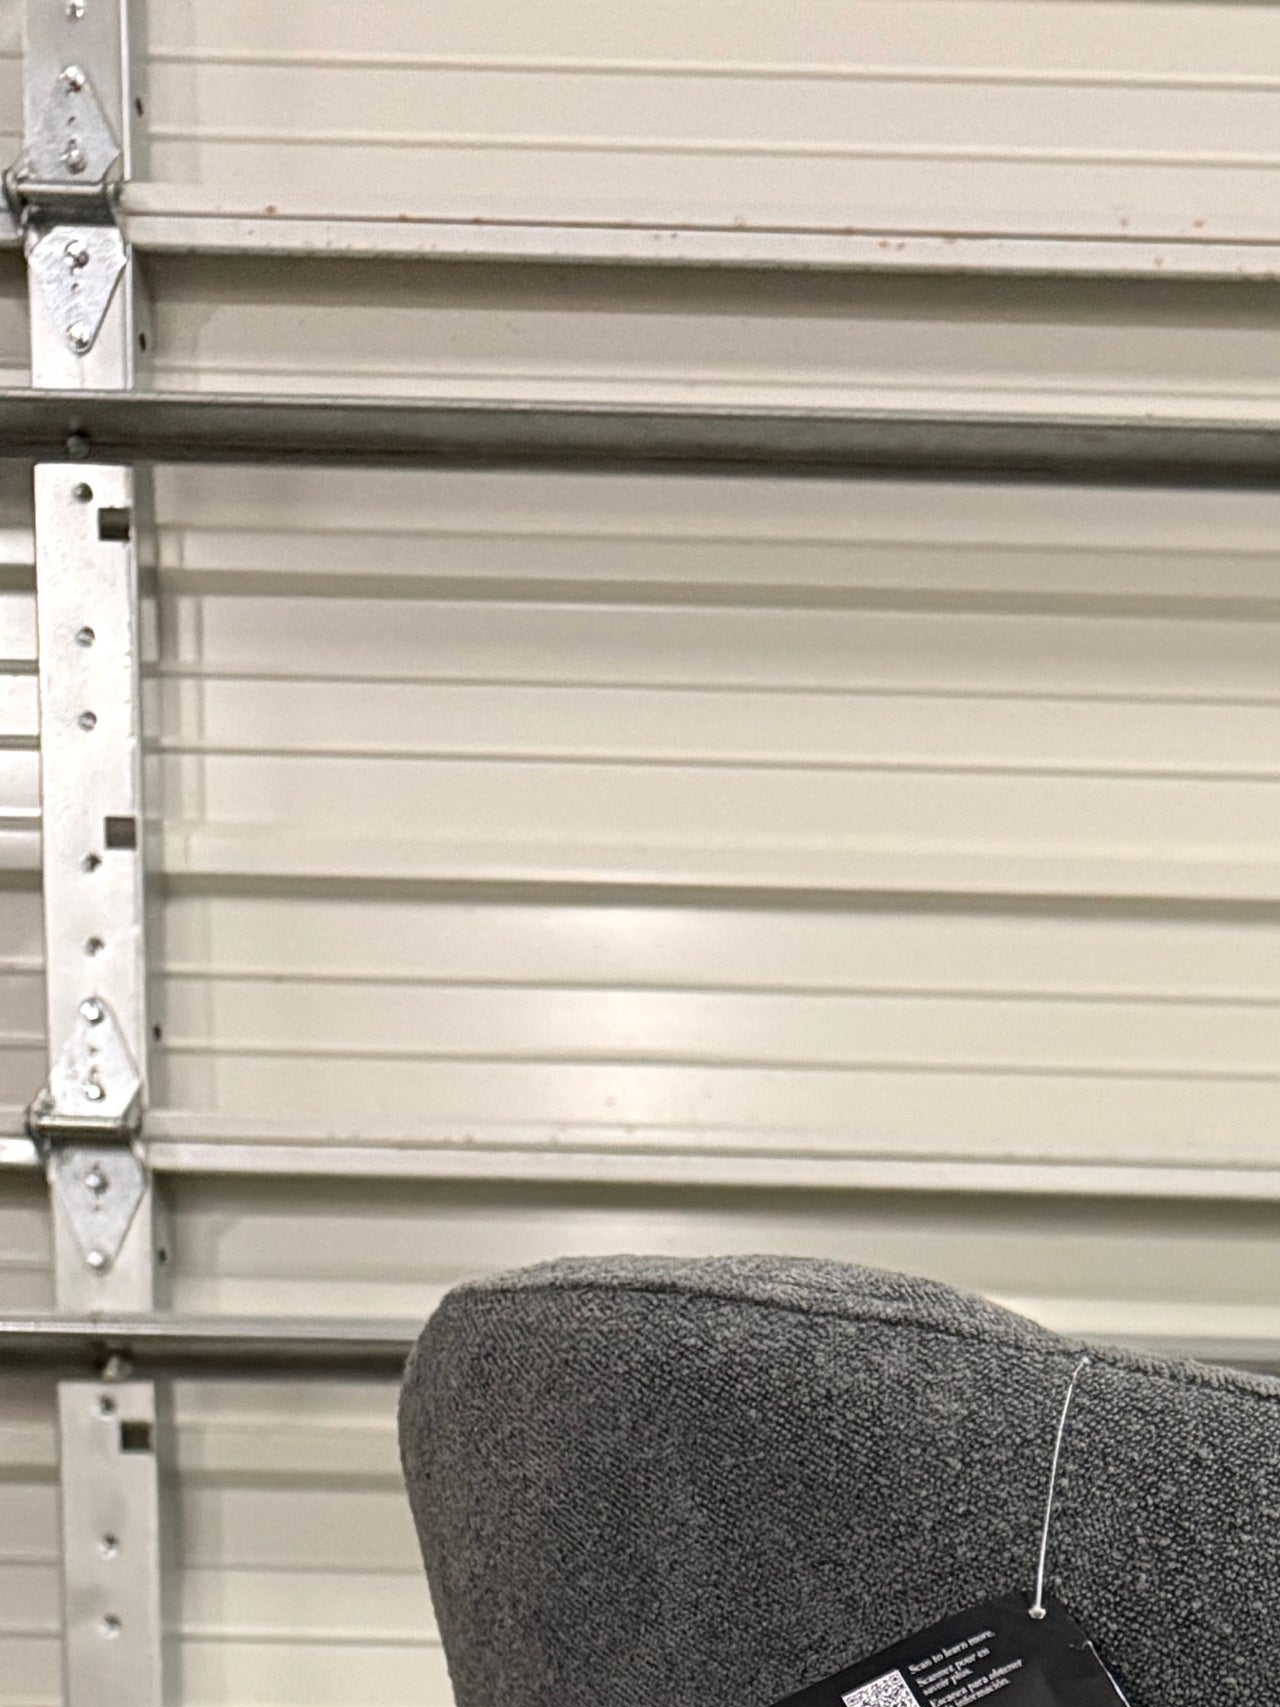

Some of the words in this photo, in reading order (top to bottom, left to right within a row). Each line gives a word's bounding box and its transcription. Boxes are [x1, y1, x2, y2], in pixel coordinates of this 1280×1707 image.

[908, 1659, 933, 1675] Scan
[931, 1653, 944, 1664] to
[941, 1641, 969, 1658] learn
[967, 1630, 996, 1647] more.
[954, 1653, 976, 1672] pour
[967, 1676, 990, 1694] para
